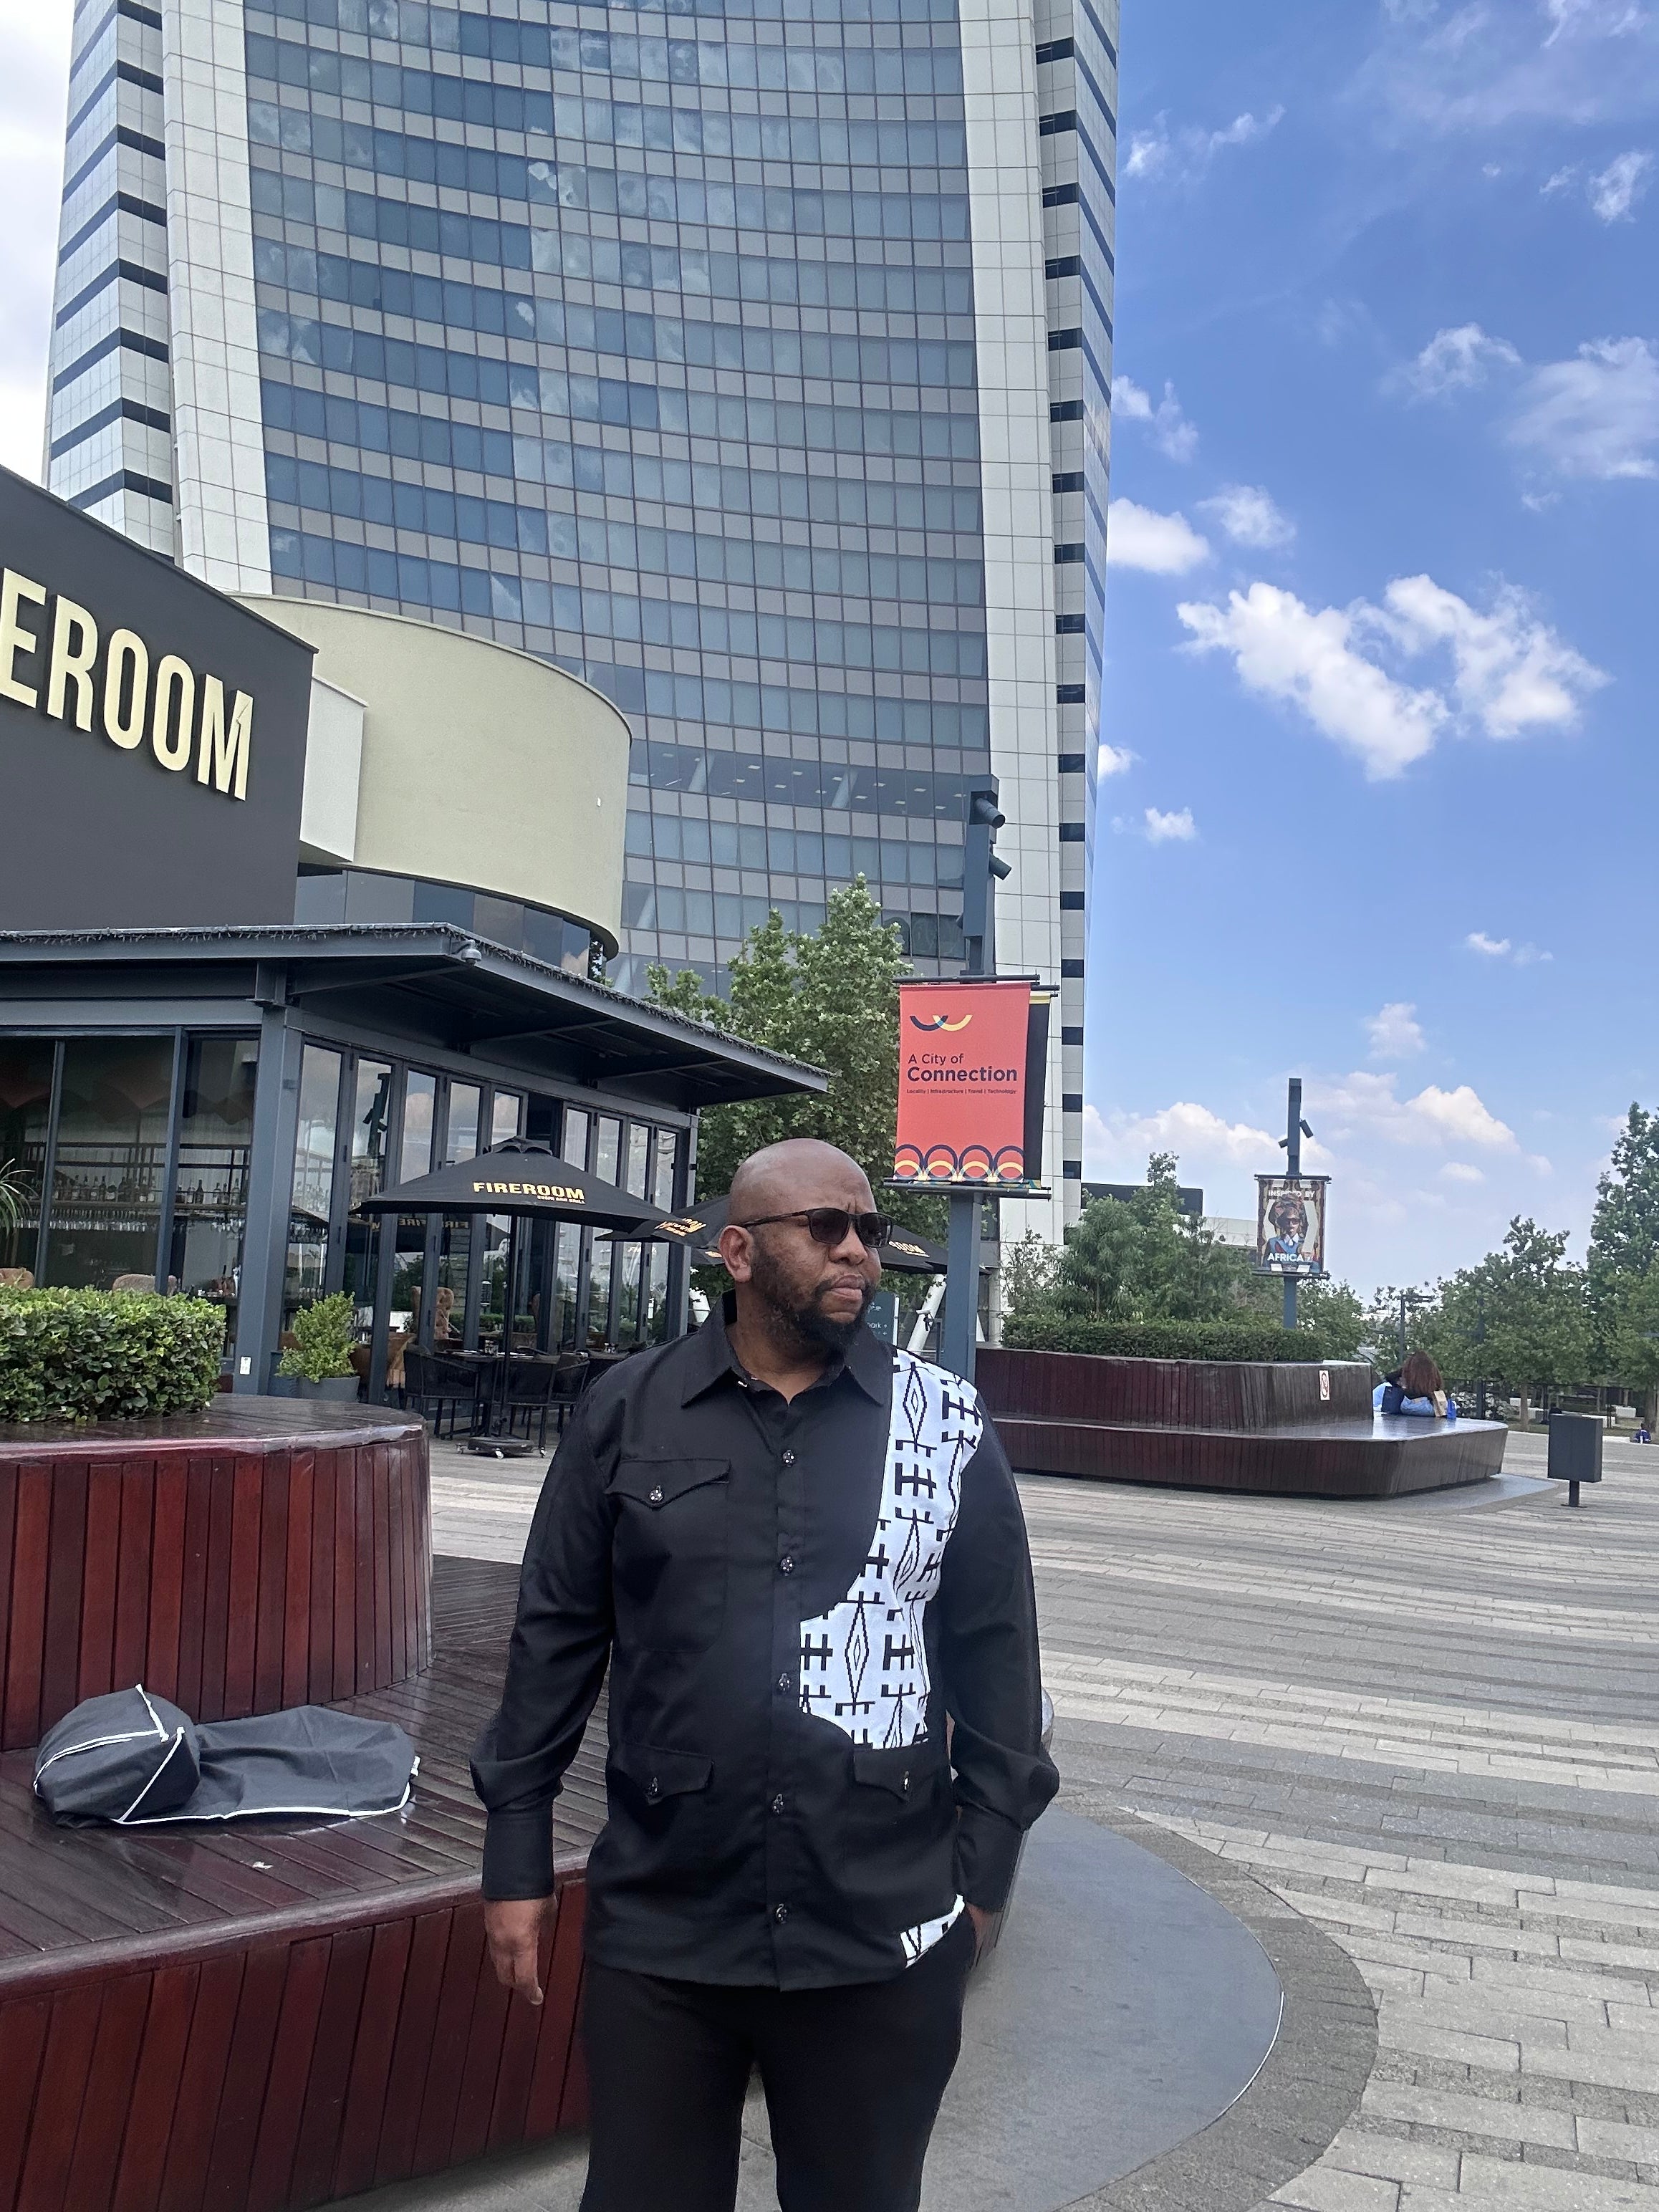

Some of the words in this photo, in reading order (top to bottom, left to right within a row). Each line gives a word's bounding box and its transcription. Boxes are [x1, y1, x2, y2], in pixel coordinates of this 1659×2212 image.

[0, 567, 254, 802] EROOM
[908, 1054, 918, 1064] A
[921, 1053, 946, 1066] City
[951, 1053, 964, 1064] of
[907, 1066, 1017, 1082] Connection
[472, 1181, 586, 1201] FIREROOM
[1267, 1252, 1304, 1262] AFRICA
